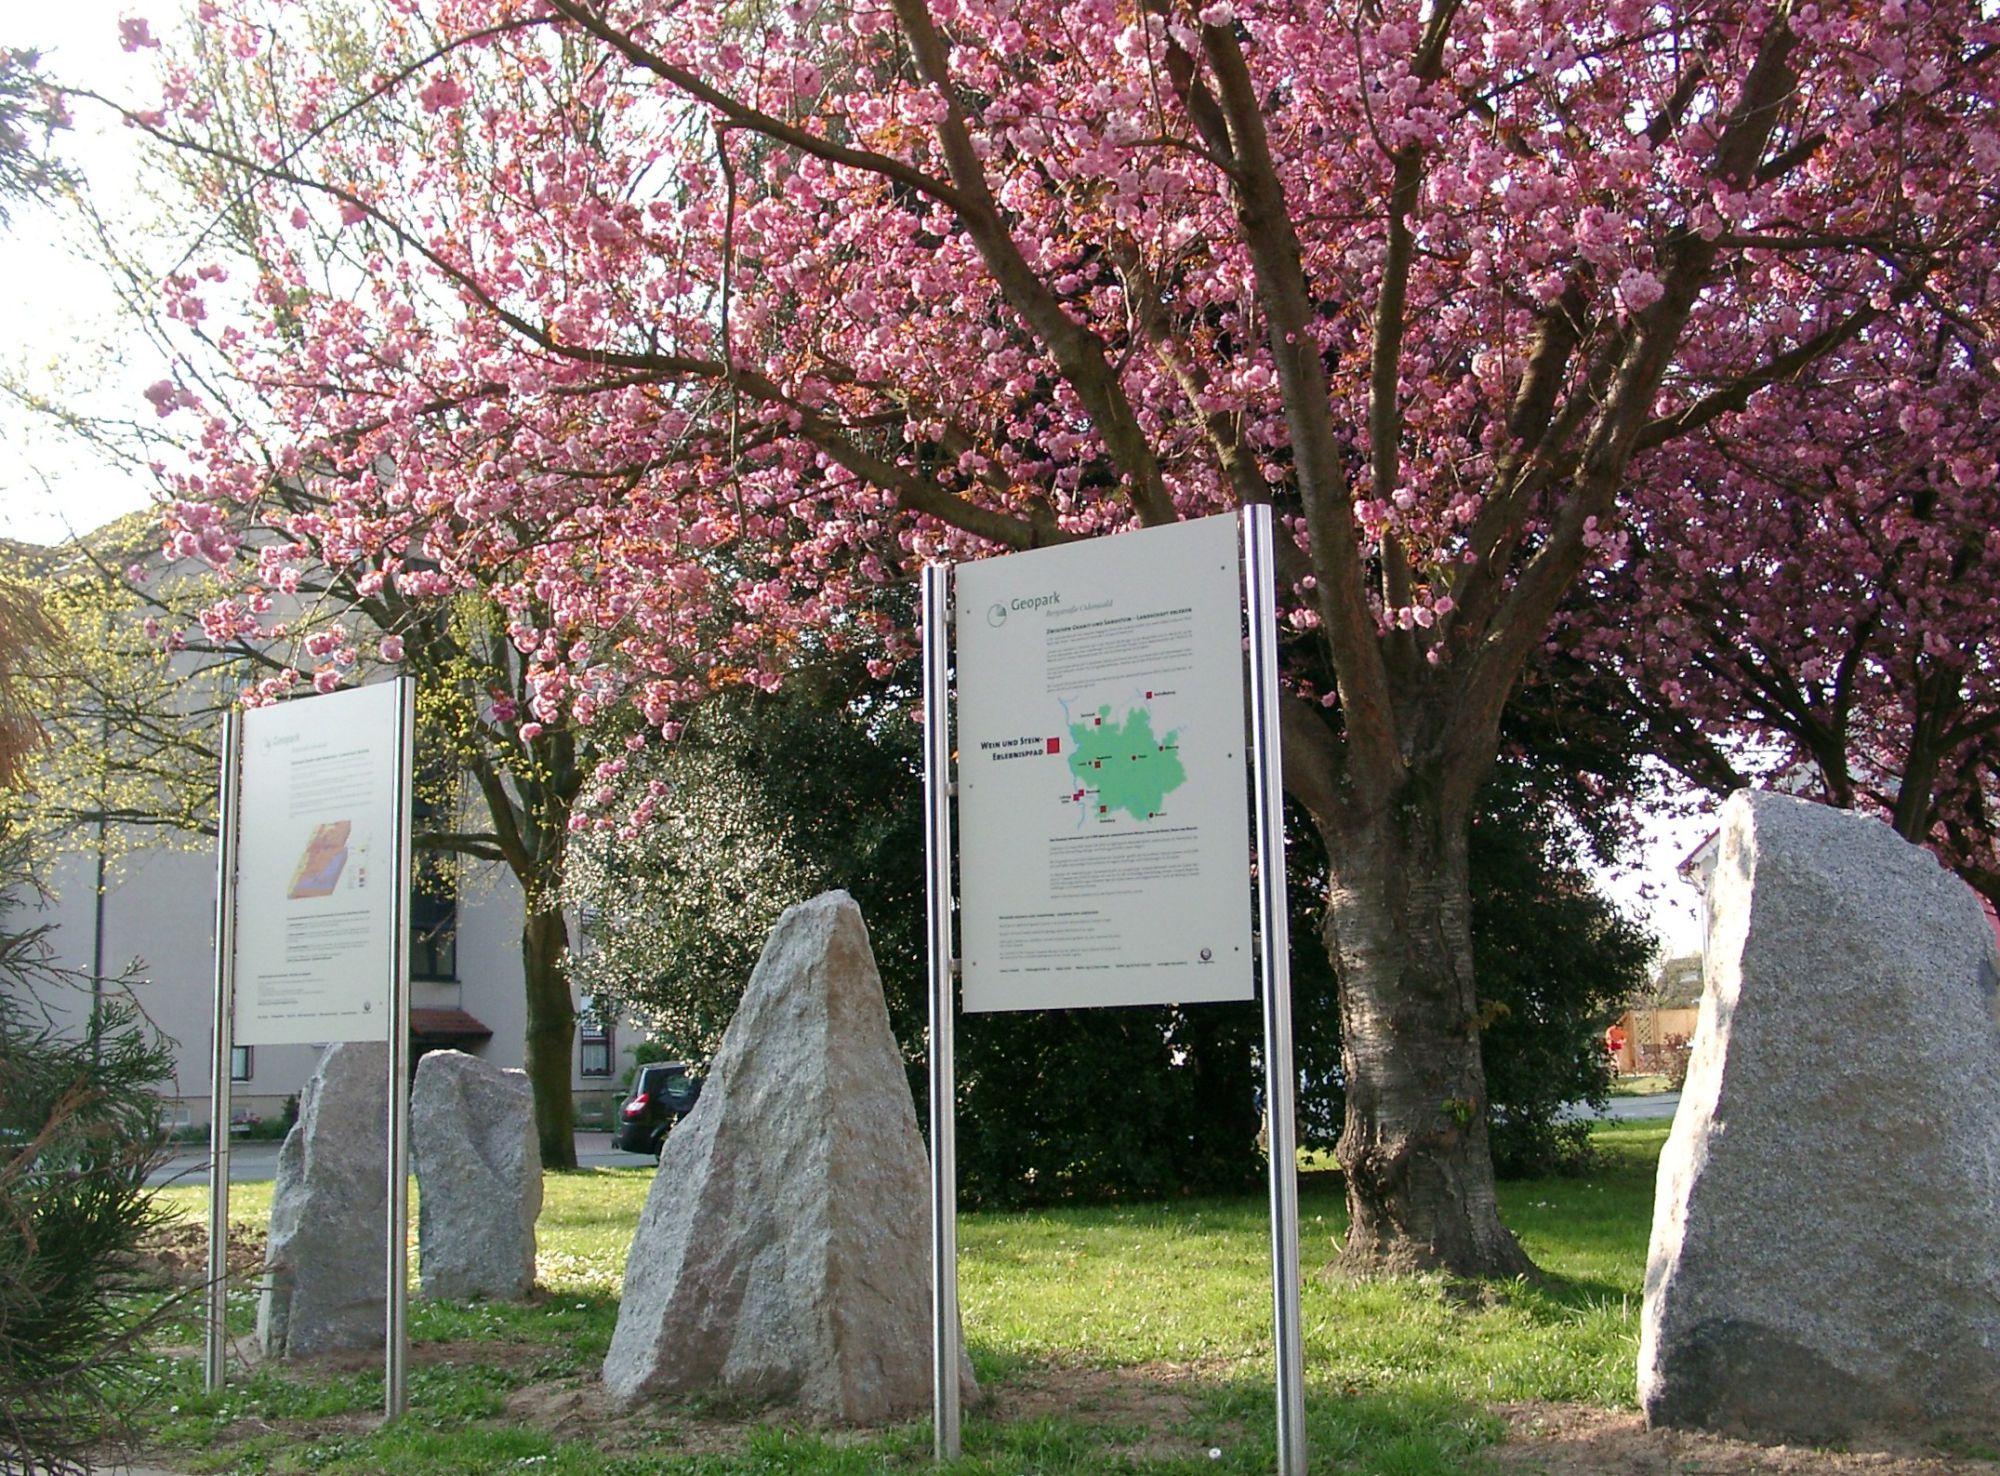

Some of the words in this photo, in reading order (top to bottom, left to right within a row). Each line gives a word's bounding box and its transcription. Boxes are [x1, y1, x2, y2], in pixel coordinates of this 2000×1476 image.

[1011, 591, 1061, 611] Geopark
[981, 741, 1000, 750] WEIN
[1002, 739, 1018, 747] UND
